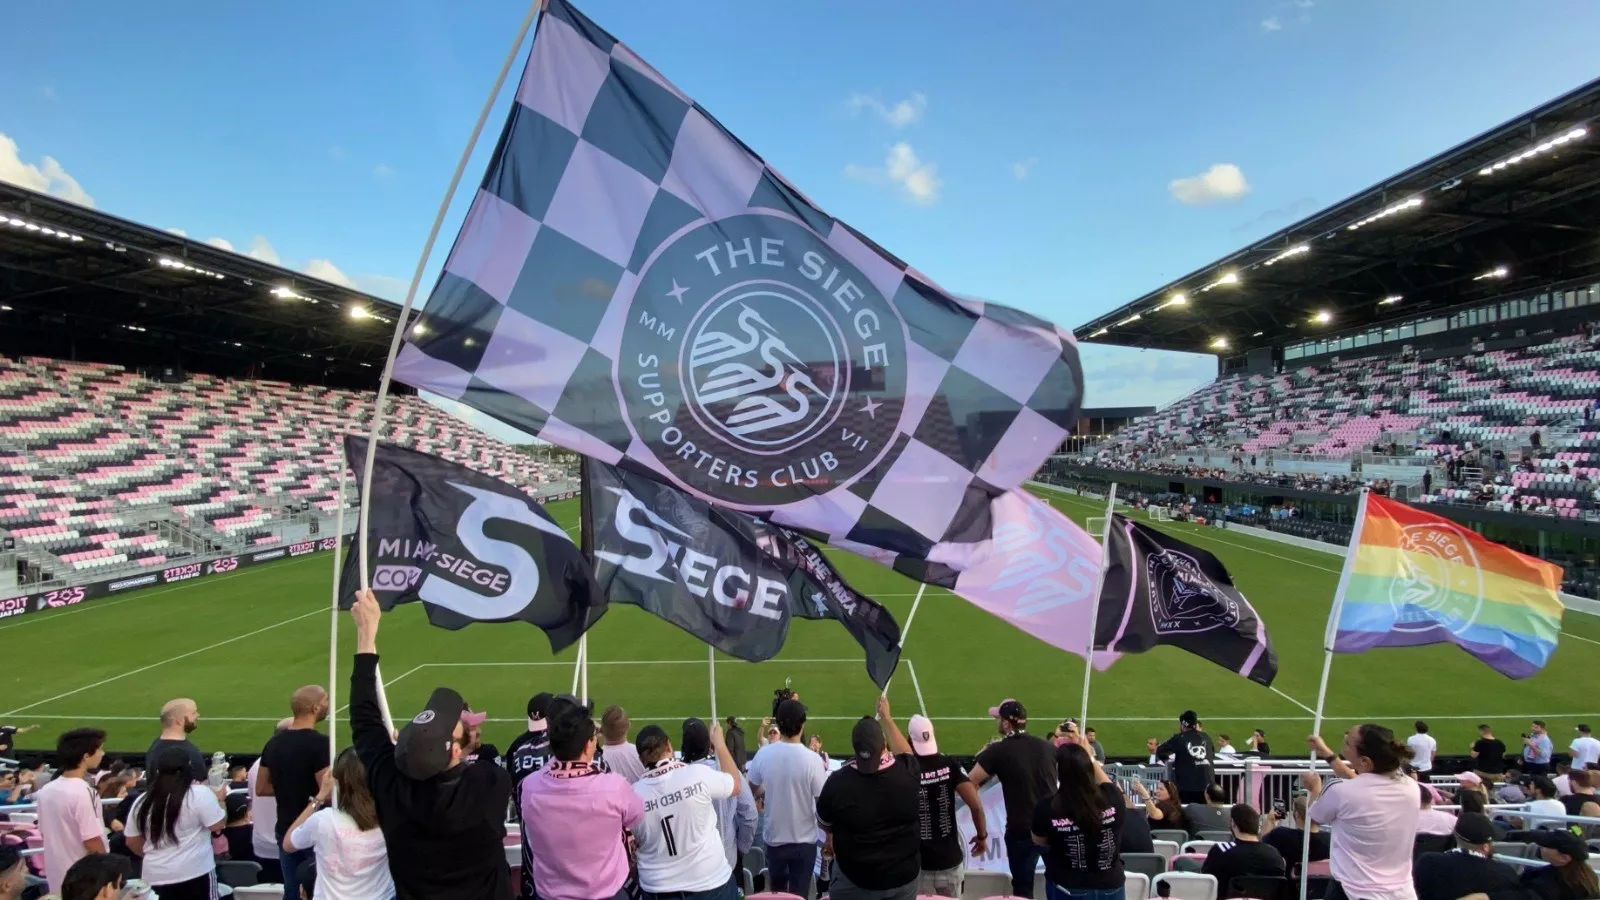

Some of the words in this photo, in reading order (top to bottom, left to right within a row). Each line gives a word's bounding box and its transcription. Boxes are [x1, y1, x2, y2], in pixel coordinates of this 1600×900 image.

[695, 237, 785, 277] THE
[797, 251, 890, 371] SIEGE
[639, 310, 675, 341] MM
[638, 352, 759, 488] SUPPORTERS
[771, 451, 839, 487] CLUB
[841, 427, 869, 451] VII
[436, 553, 510, 593] SIEGE
